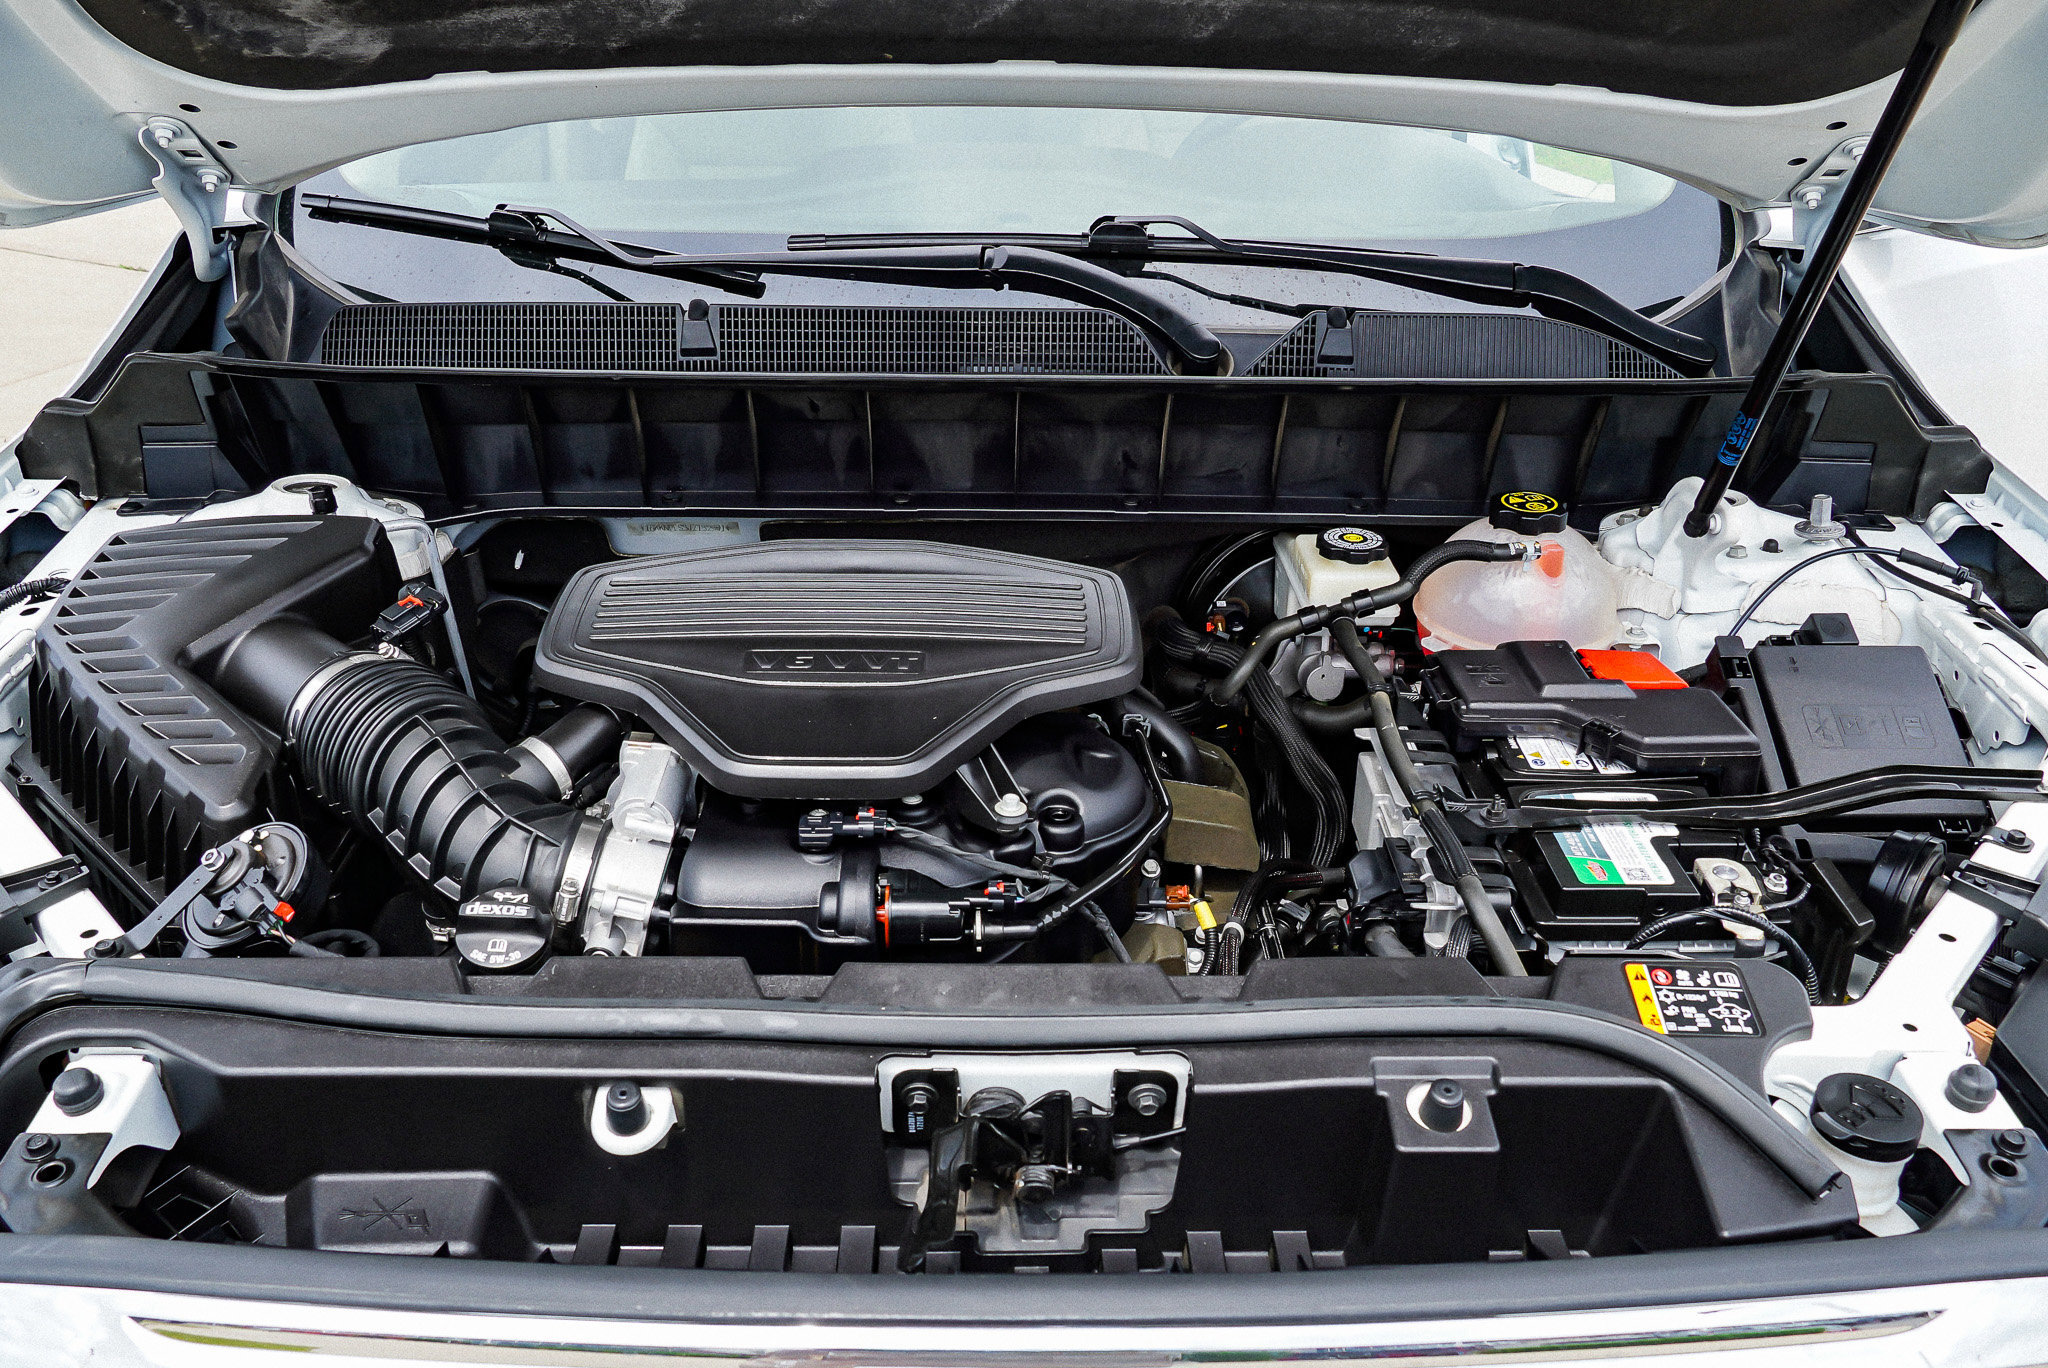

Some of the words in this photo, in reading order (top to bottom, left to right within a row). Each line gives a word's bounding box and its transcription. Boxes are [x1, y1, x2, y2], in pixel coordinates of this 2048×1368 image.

[751, 653, 814, 669] V6
[825, 654, 919, 670] VVT
[465, 902, 530, 915] dexos
[470, 949, 487, 962] SAE
[489, 950, 521, 964] 5W-30
